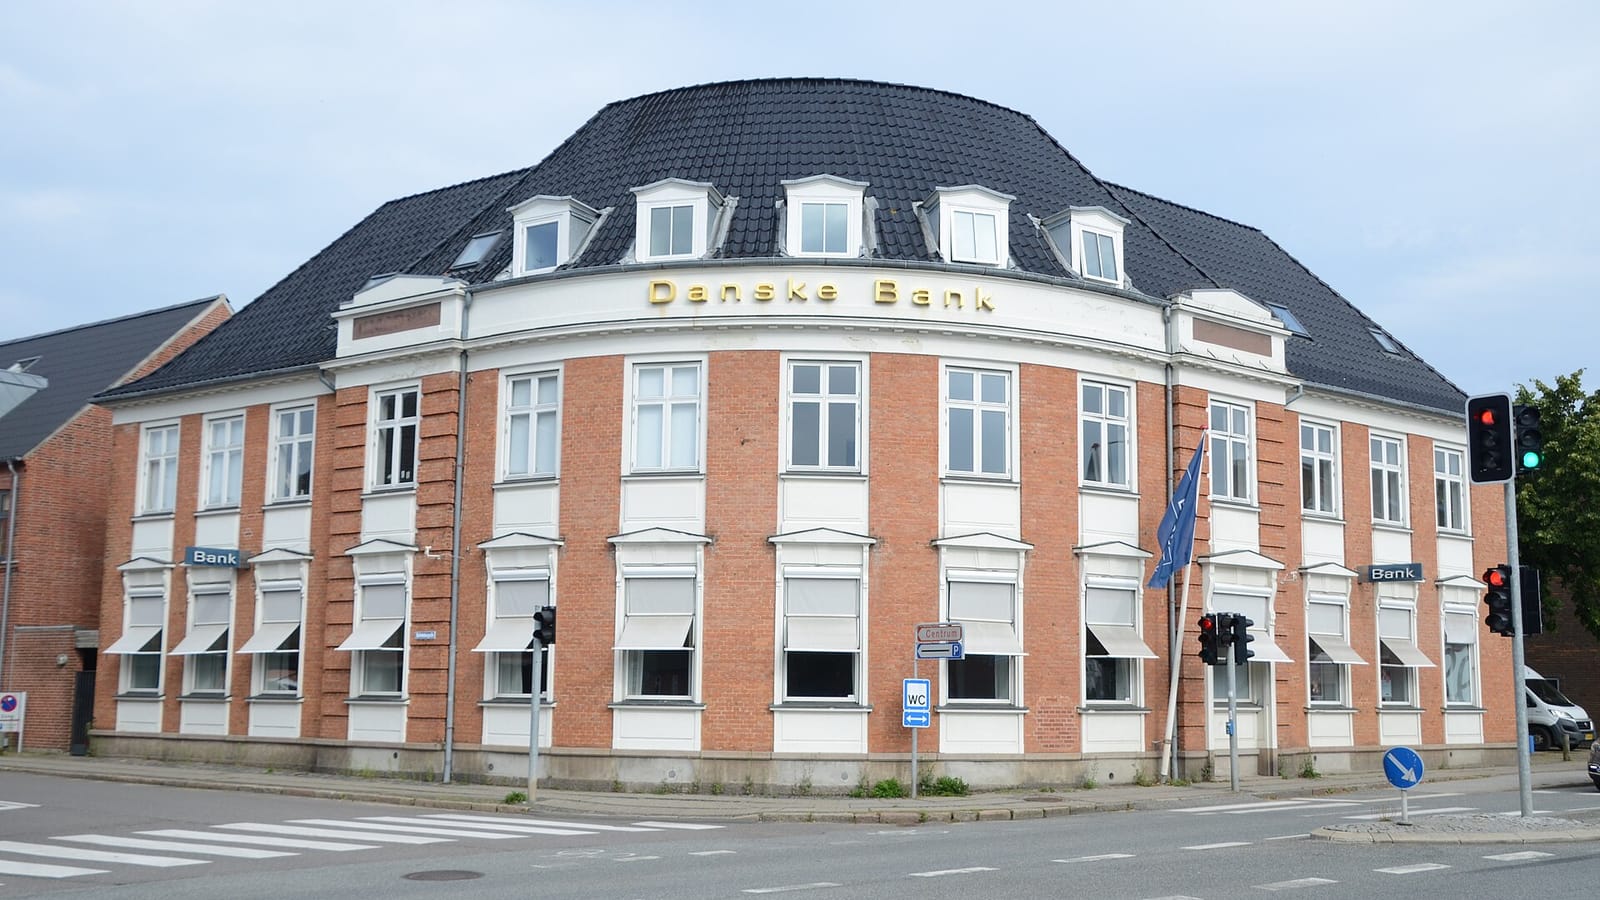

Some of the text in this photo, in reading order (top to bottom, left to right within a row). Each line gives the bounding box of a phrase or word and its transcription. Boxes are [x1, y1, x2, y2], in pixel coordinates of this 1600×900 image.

[648, 277, 996, 311] Danske Bank
[193, 551, 237, 564] Bank
[1372, 568, 1415, 579] Bank
[925, 629, 958, 638] Centrum
[953, 645, 960, 656] P
[908, 694, 926, 706] WC
